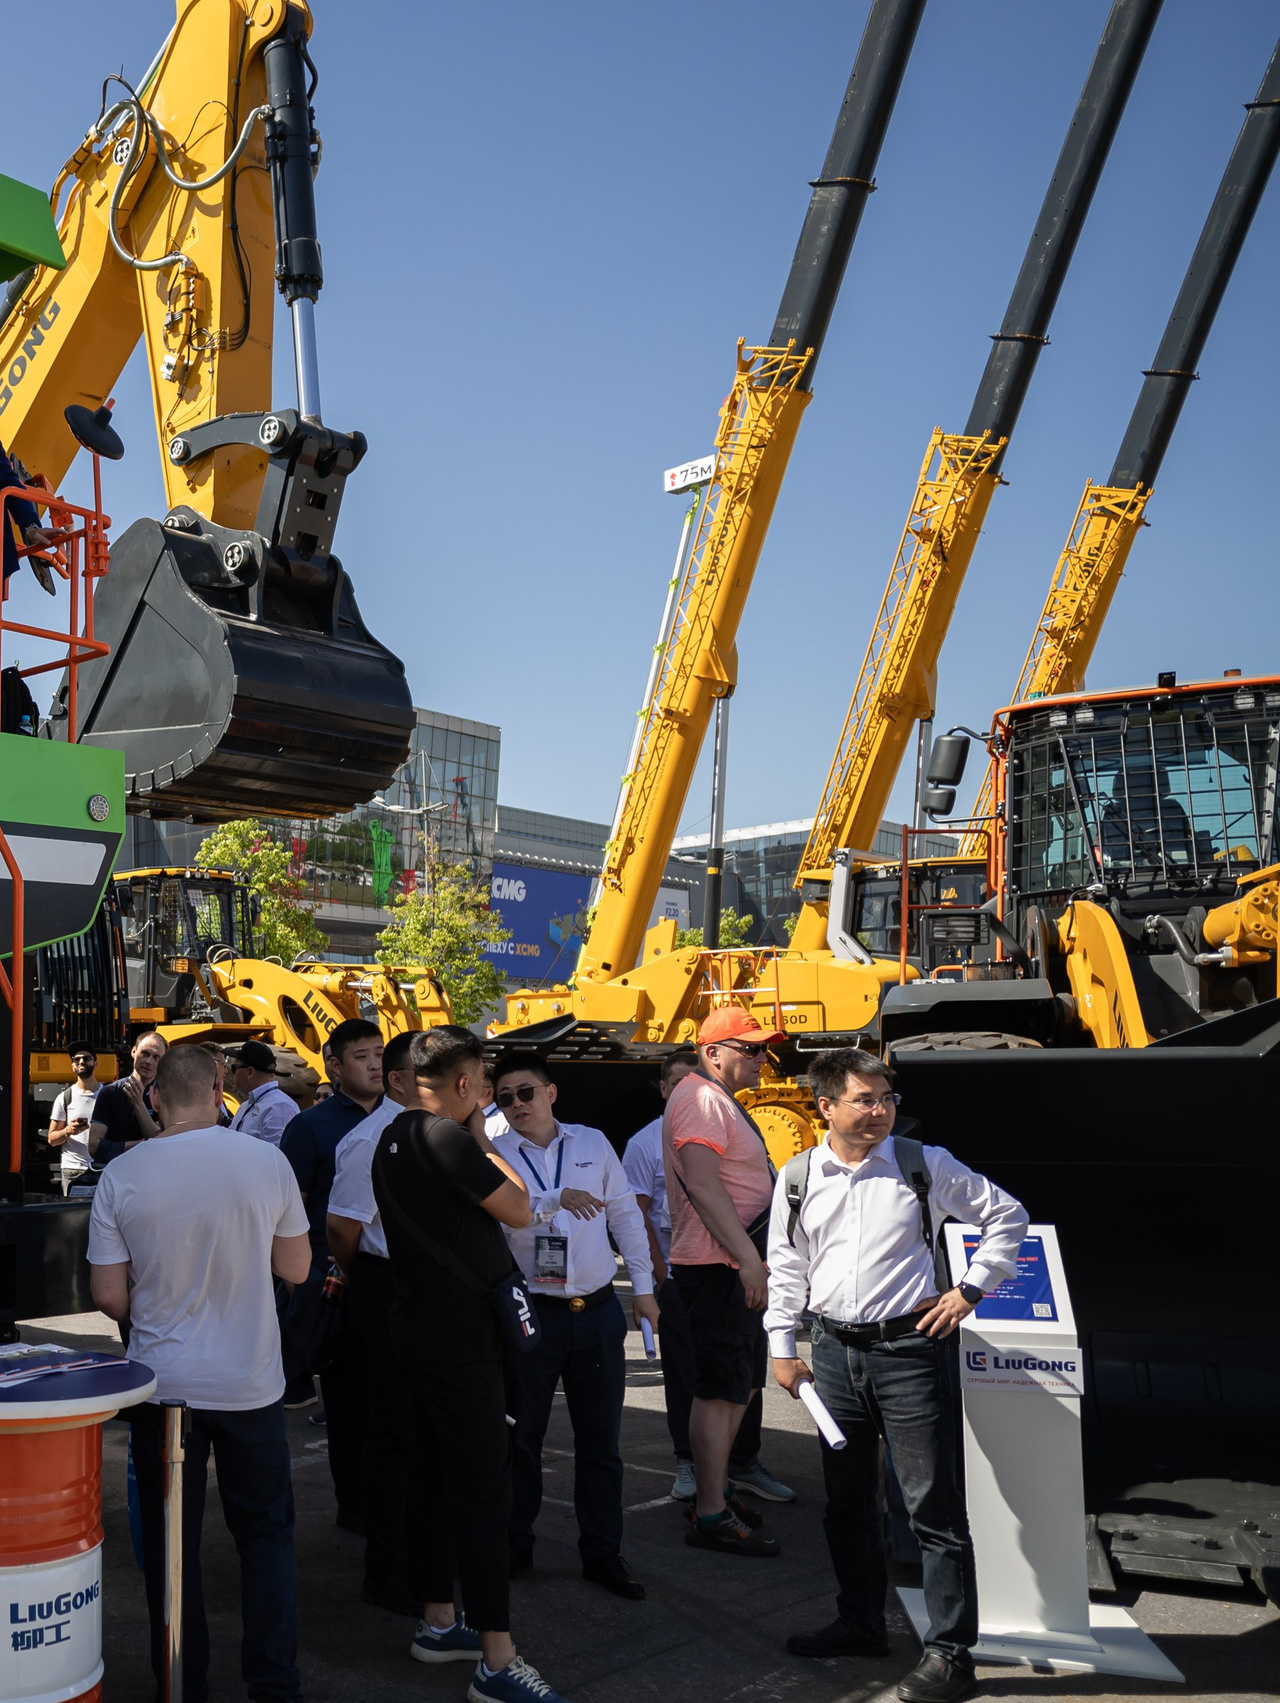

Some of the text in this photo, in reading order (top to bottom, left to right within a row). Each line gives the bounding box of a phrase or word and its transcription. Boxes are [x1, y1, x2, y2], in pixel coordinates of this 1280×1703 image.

[476, 939, 507, 954] СПЕХУ
[515, 943, 540, 957] XCMG
[11, 1620, 71, 1652] 柳工
